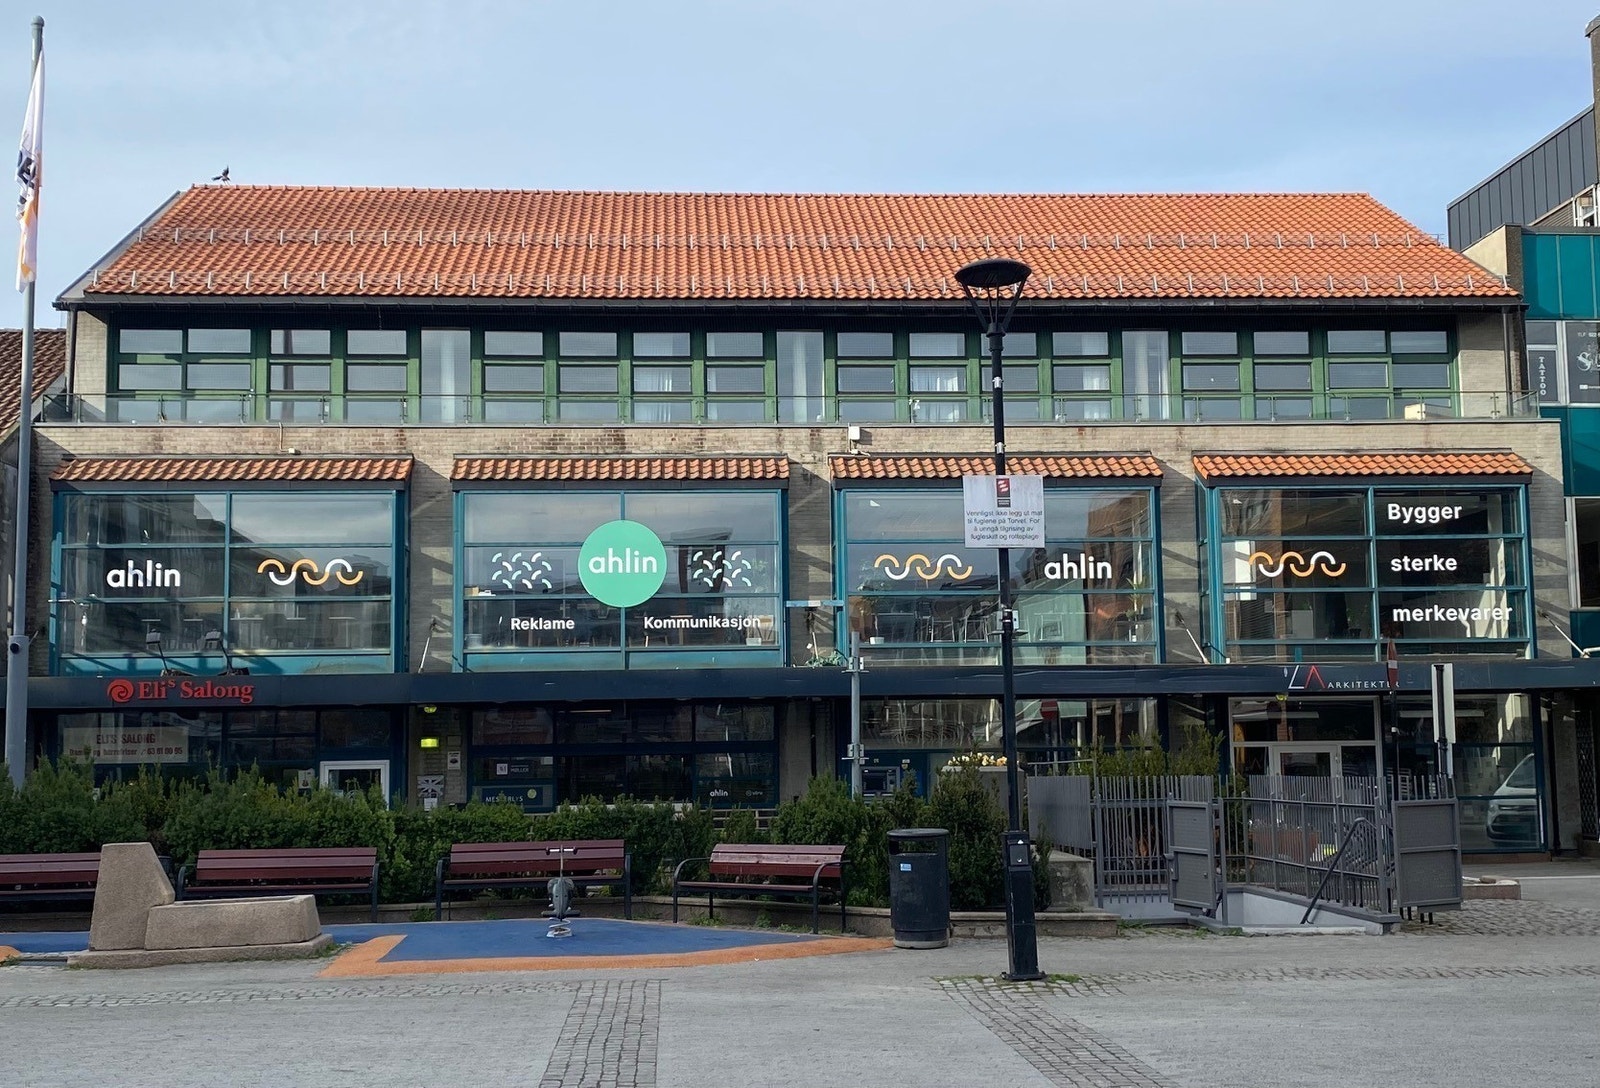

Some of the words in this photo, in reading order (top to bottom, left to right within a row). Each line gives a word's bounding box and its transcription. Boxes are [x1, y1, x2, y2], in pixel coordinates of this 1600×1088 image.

[1538, 356, 1547, 396] TATTOO
[966, 510, 994, 518] Vennligst
[1387, 503, 1463, 524] Bygger
[1008, 533, 1040, 541] rotteplage
[588, 547, 658, 575] ahlin
[1043, 553, 1113, 580] ahlin
[1390, 554, 1458, 572] sterke
[106, 559, 181, 588] ahlin
[1392, 604, 1514, 622] merkevarer
[510, 617, 575, 631] Reklame
[643, 614, 762, 631] Kommunikasjon
[180, 680, 255, 704] Salong
[121, 733, 156, 744] SALONG
[485, 795, 524, 803] MESERLYS
[709, 788, 729, 797] ahlin
